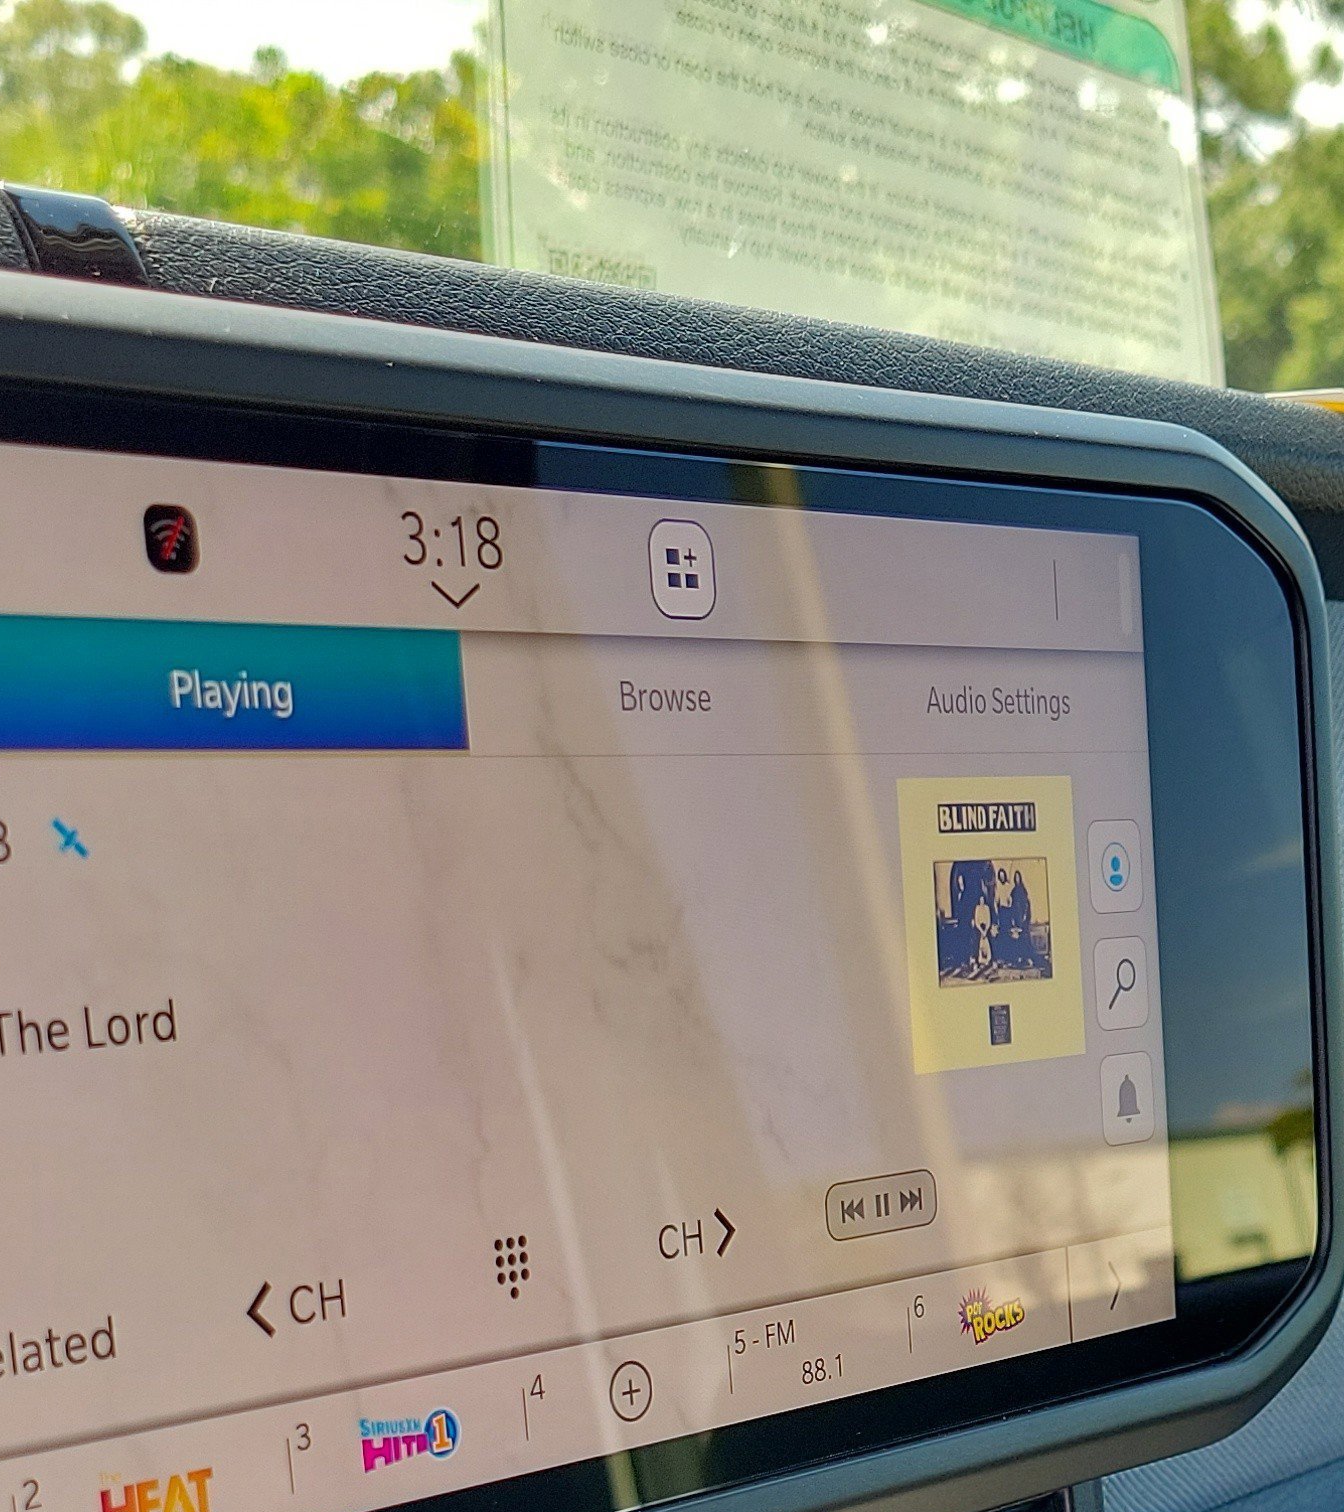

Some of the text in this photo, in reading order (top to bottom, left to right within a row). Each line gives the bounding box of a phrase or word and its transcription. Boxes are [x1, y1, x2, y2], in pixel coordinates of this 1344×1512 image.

[400, 509, 504, 570] 3:18
[169, 667, 294, 719] Playing
[619, 680, 712, 713] Browse
[926, 685, 1071, 722] Audio Settings
[939, 803, 1036, 831] BLIND FAITH
[84, 999, 179, 1050] Lord
[658, 1221, 704, 1261] CH
[289, 1279, 348, 1324] CH
[913, 1294, 926, 1320] 6
[734, 1328, 749, 1356] 5
[765, 1318, 797, 1347] FM
[973, 1301, 1024, 1343] ROCKS
[529, 1373, 546, 1401] 4
[801, 1353, 846, 1386] 88.1
[295, 1423, 313, 1452] 3
[22, 1479, 43, 1511] 2
